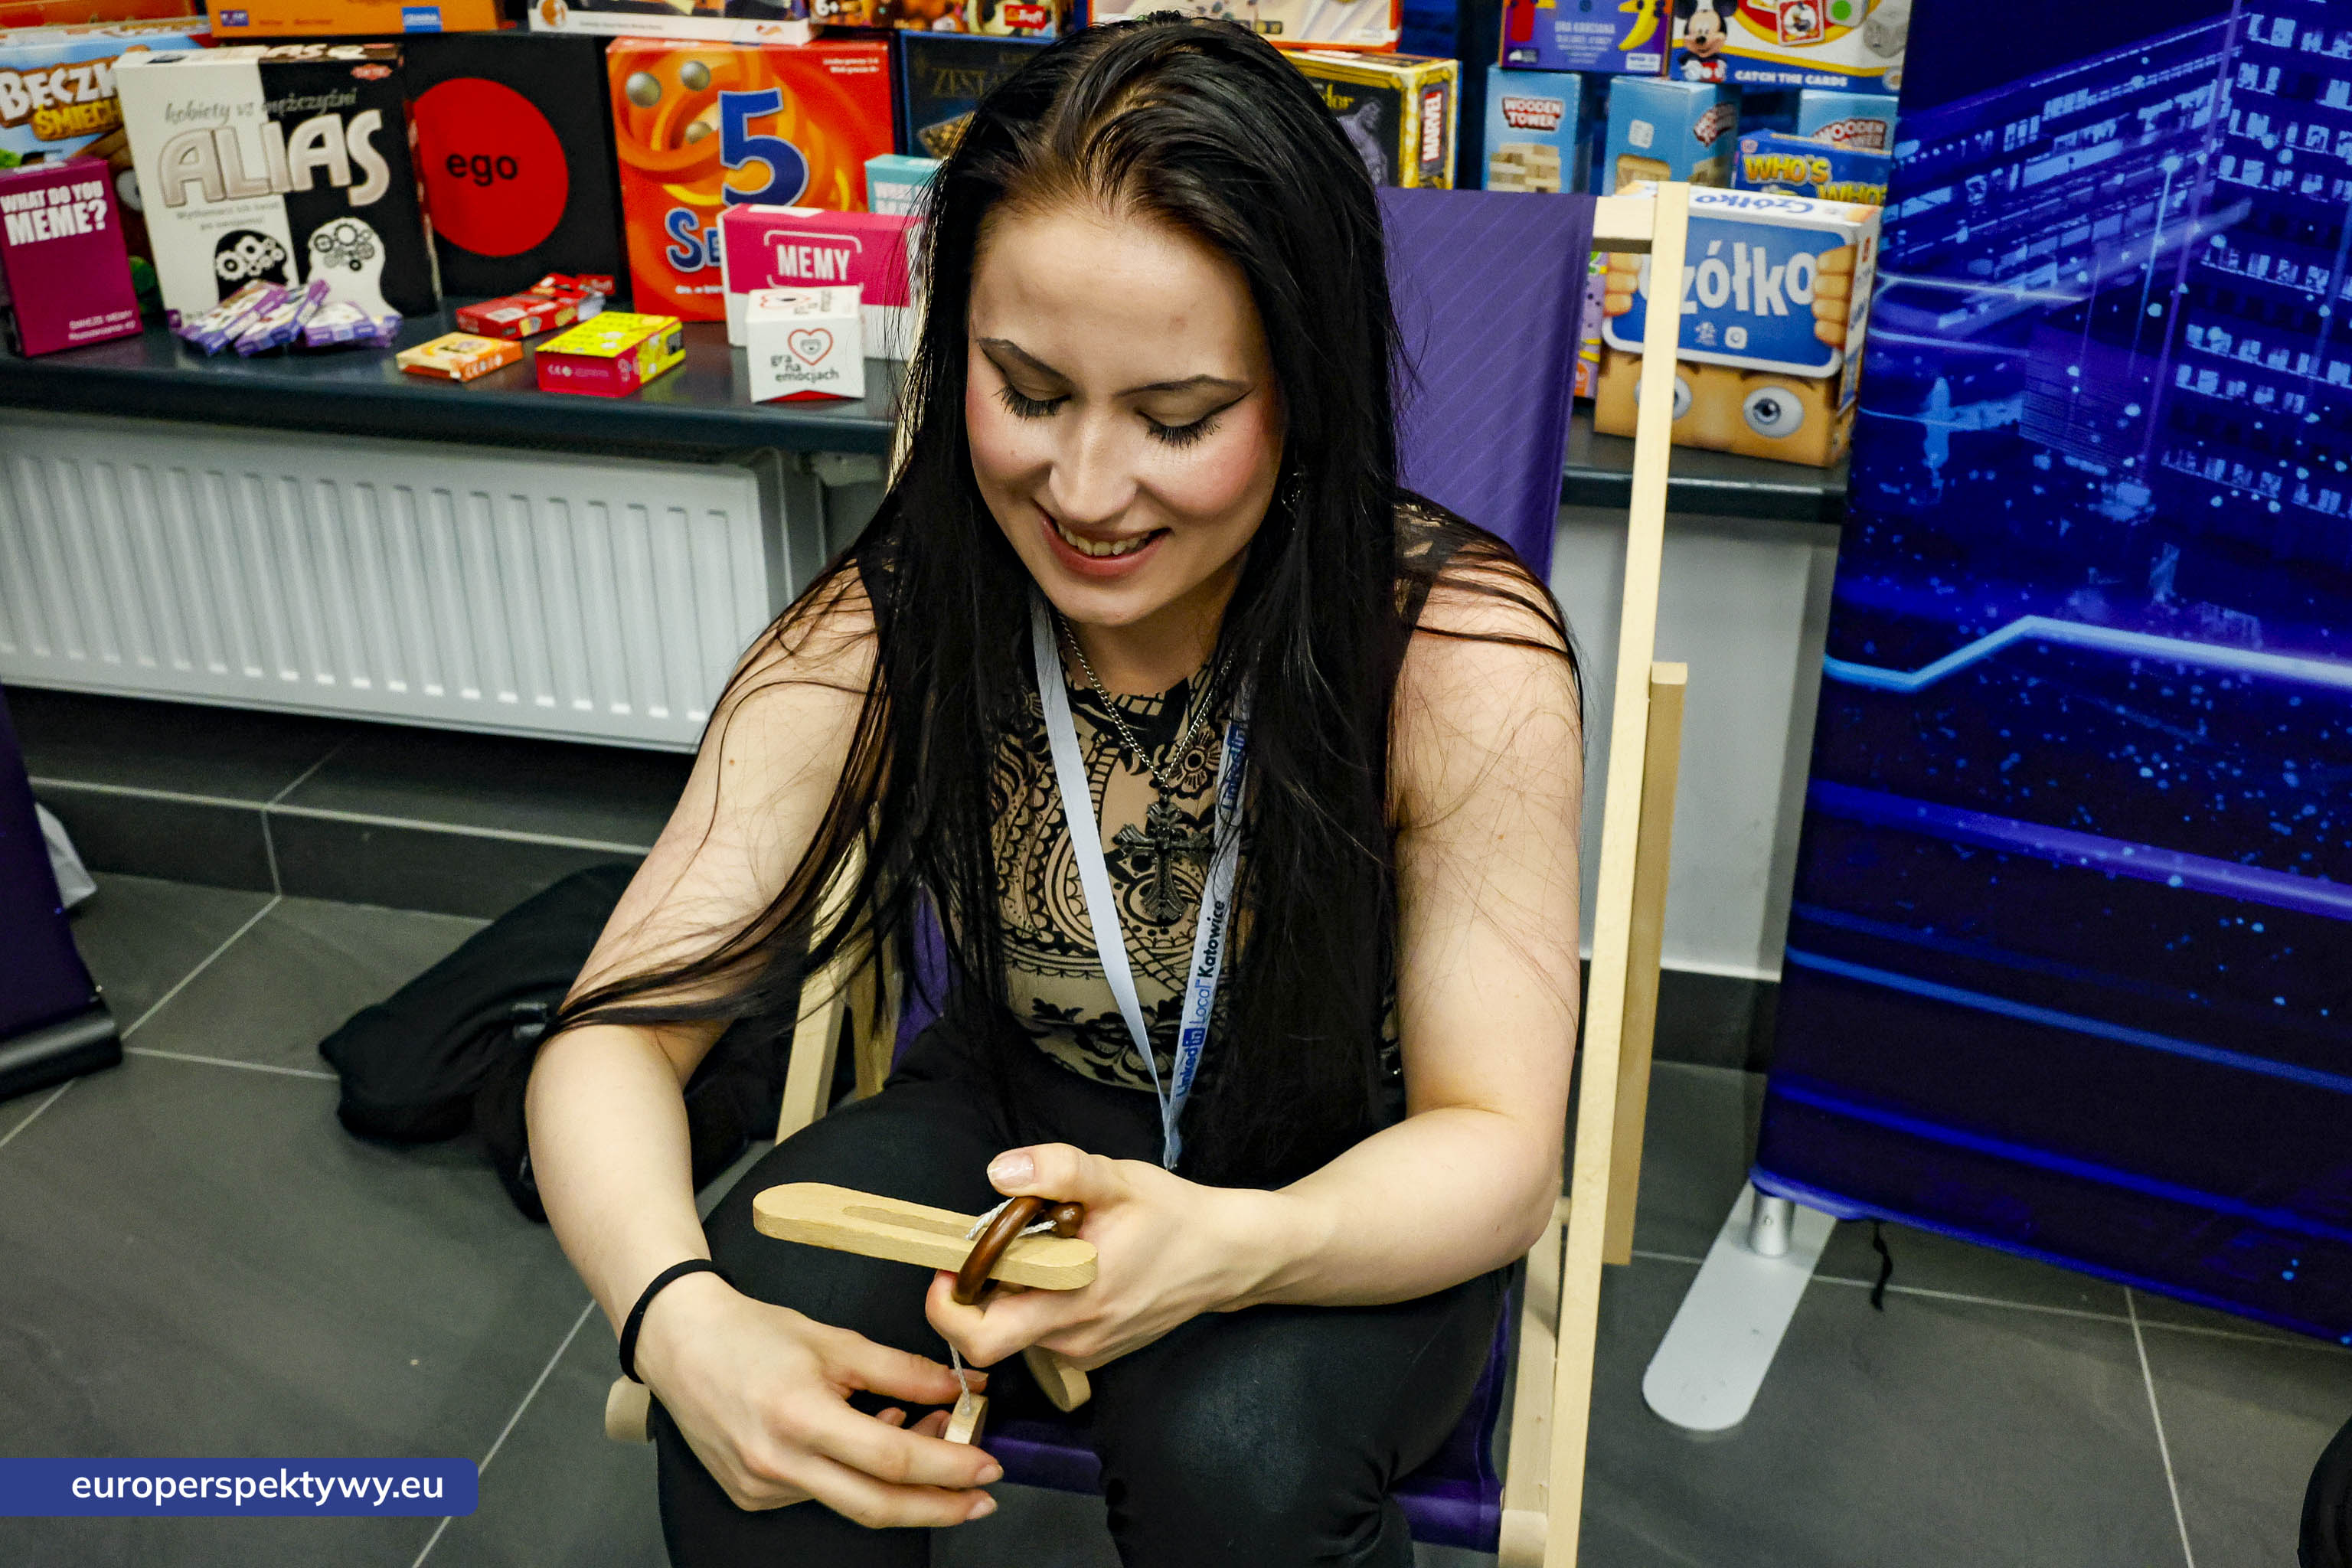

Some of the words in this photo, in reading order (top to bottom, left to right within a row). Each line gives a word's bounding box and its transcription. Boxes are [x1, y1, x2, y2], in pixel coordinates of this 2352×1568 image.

[0, 61, 118, 121] BECZK
[1734, 70, 1776, 83] CATCH
[1778, 73, 1803, 84] THE
[1805, 74, 1847, 87] CARDS
[1504, 98, 1562, 114] WOODEN
[1422, 91, 1442, 162] MARVEL
[158, 109, 390, 208] ALIAS
[718, 87, 809, 211] 5
[446, 154, 518, 186] ego
[1743, 155, 1831, 185] WHO'S
[0, 189, 46, 214] WHAT
[47, 185, 71, 205] DO
[70, 180, 104, 201] YOU
[4, 198, 107, 247] MEME?
[776, 243, 851, 281] MEMY
[771, 354, 792, 367] gra
[776, 368, 839, 383] emocjach
[786, 362, 801, 371] na
[1197, 900, 1226, 978] Katowice
